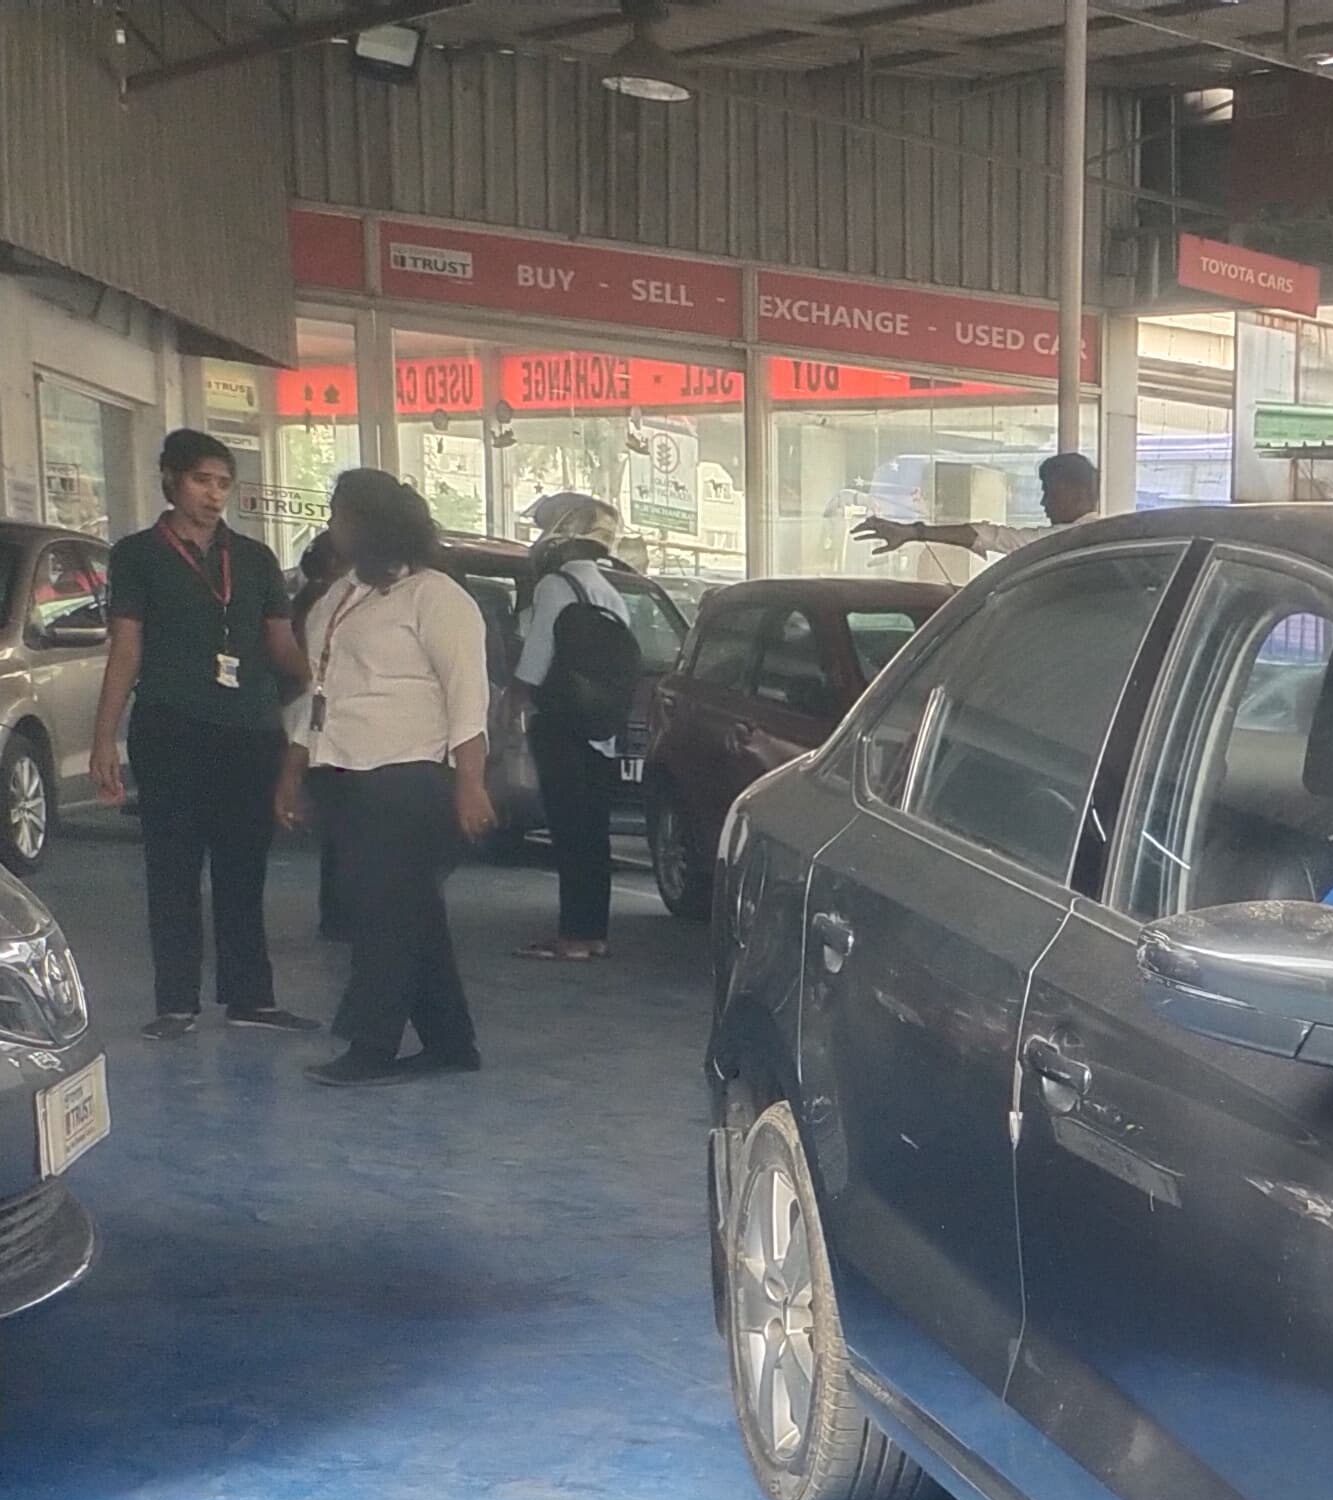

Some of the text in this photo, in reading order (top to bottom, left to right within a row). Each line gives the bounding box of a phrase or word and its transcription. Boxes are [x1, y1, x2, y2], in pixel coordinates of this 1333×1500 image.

[517, 264, 695, 307] BUY SELL
[1200, 256, 1295, 294] TOYOTA CARS
[758, 295, 910, 338] EXCHANGE
[955, 320, 1025, 352] USED
[261, 498, 328, 518] TRUST
